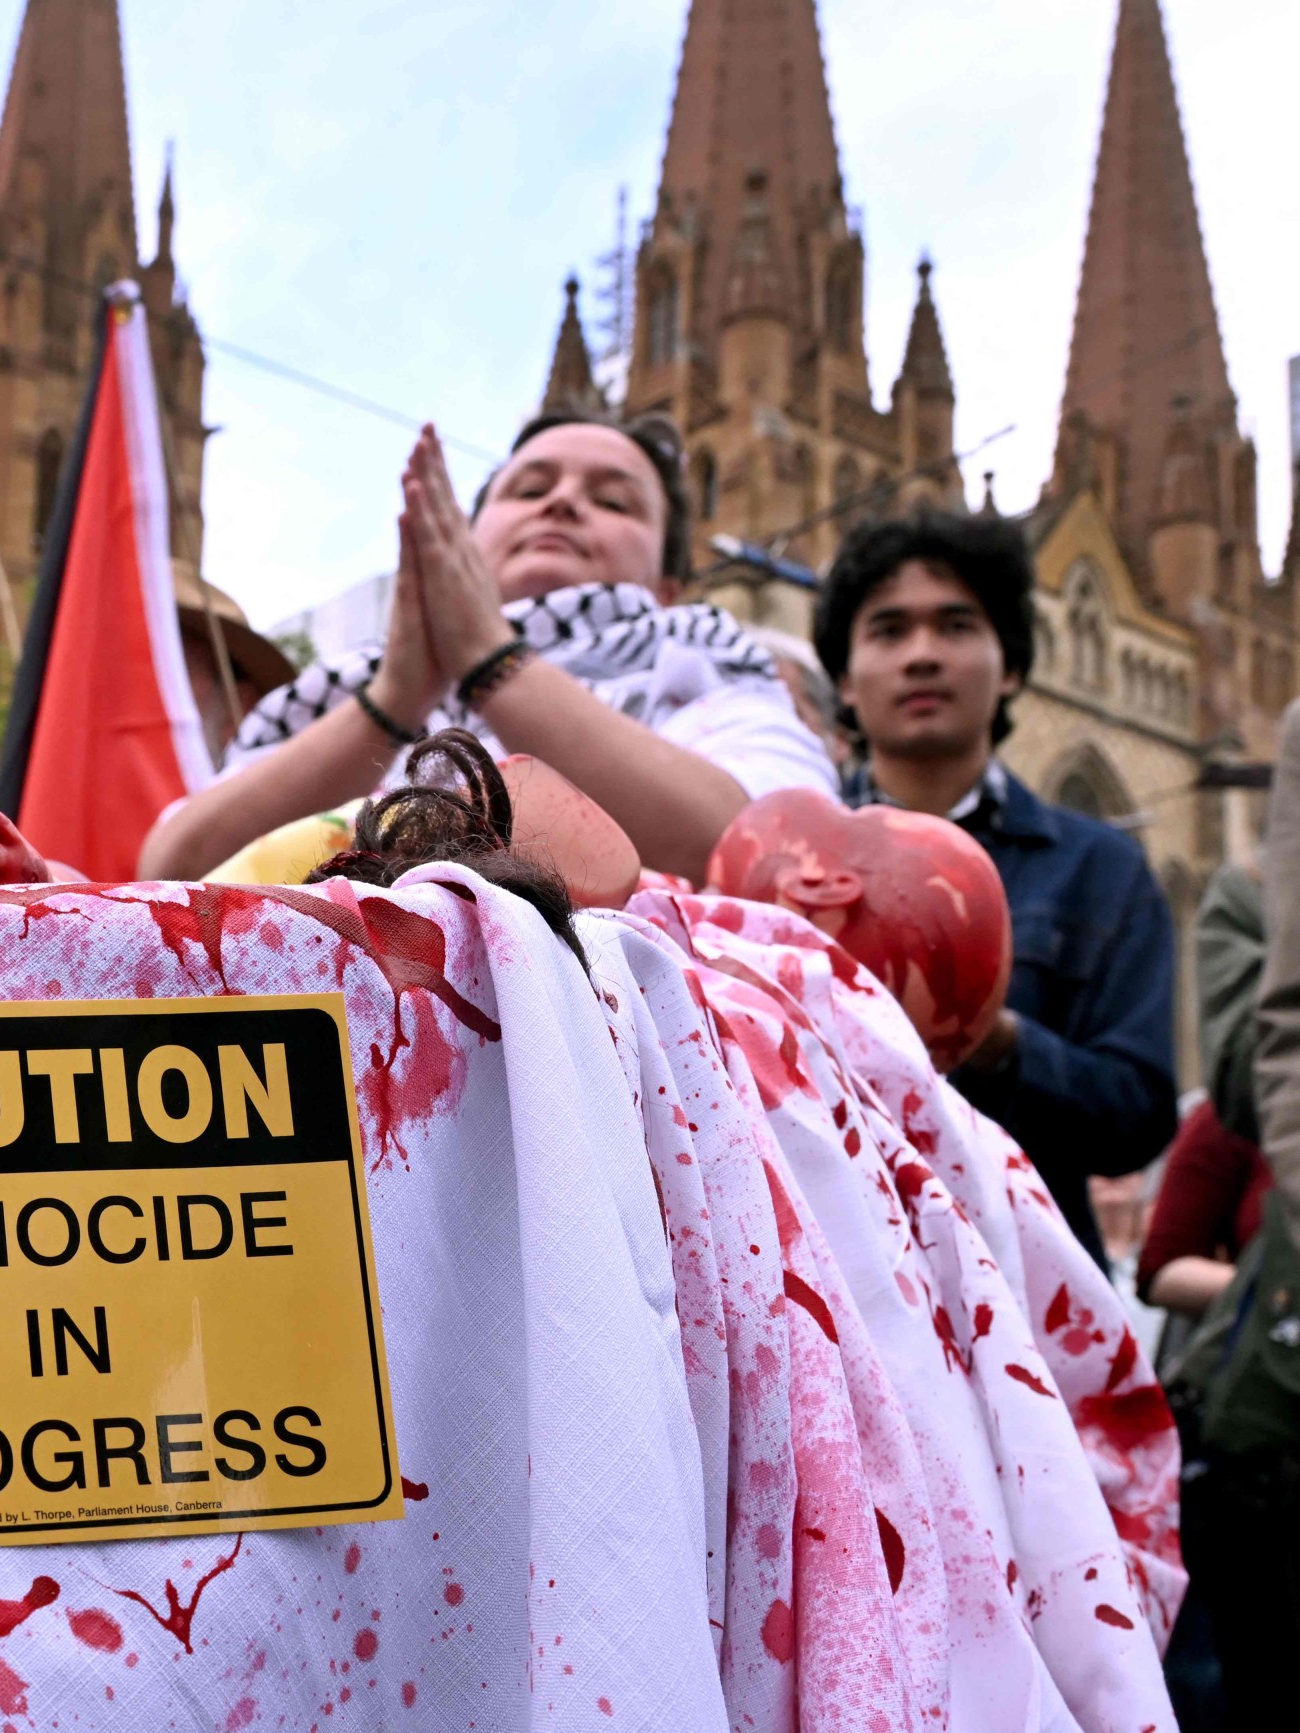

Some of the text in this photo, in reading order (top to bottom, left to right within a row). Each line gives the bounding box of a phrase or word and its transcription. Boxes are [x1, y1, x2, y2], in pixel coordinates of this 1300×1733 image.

[25, 1306, 112, 1377] IN
[5, 1512, 19, 1525] by
[21, 1511, 32, 1521] L.
[34, 1509, 76, 1521] Thorpe,
[78, 1505, 134, 1518] Parliament
[136, 1502, 173, 1514] House,
[175, 1499, 223, 1512] Canberra
